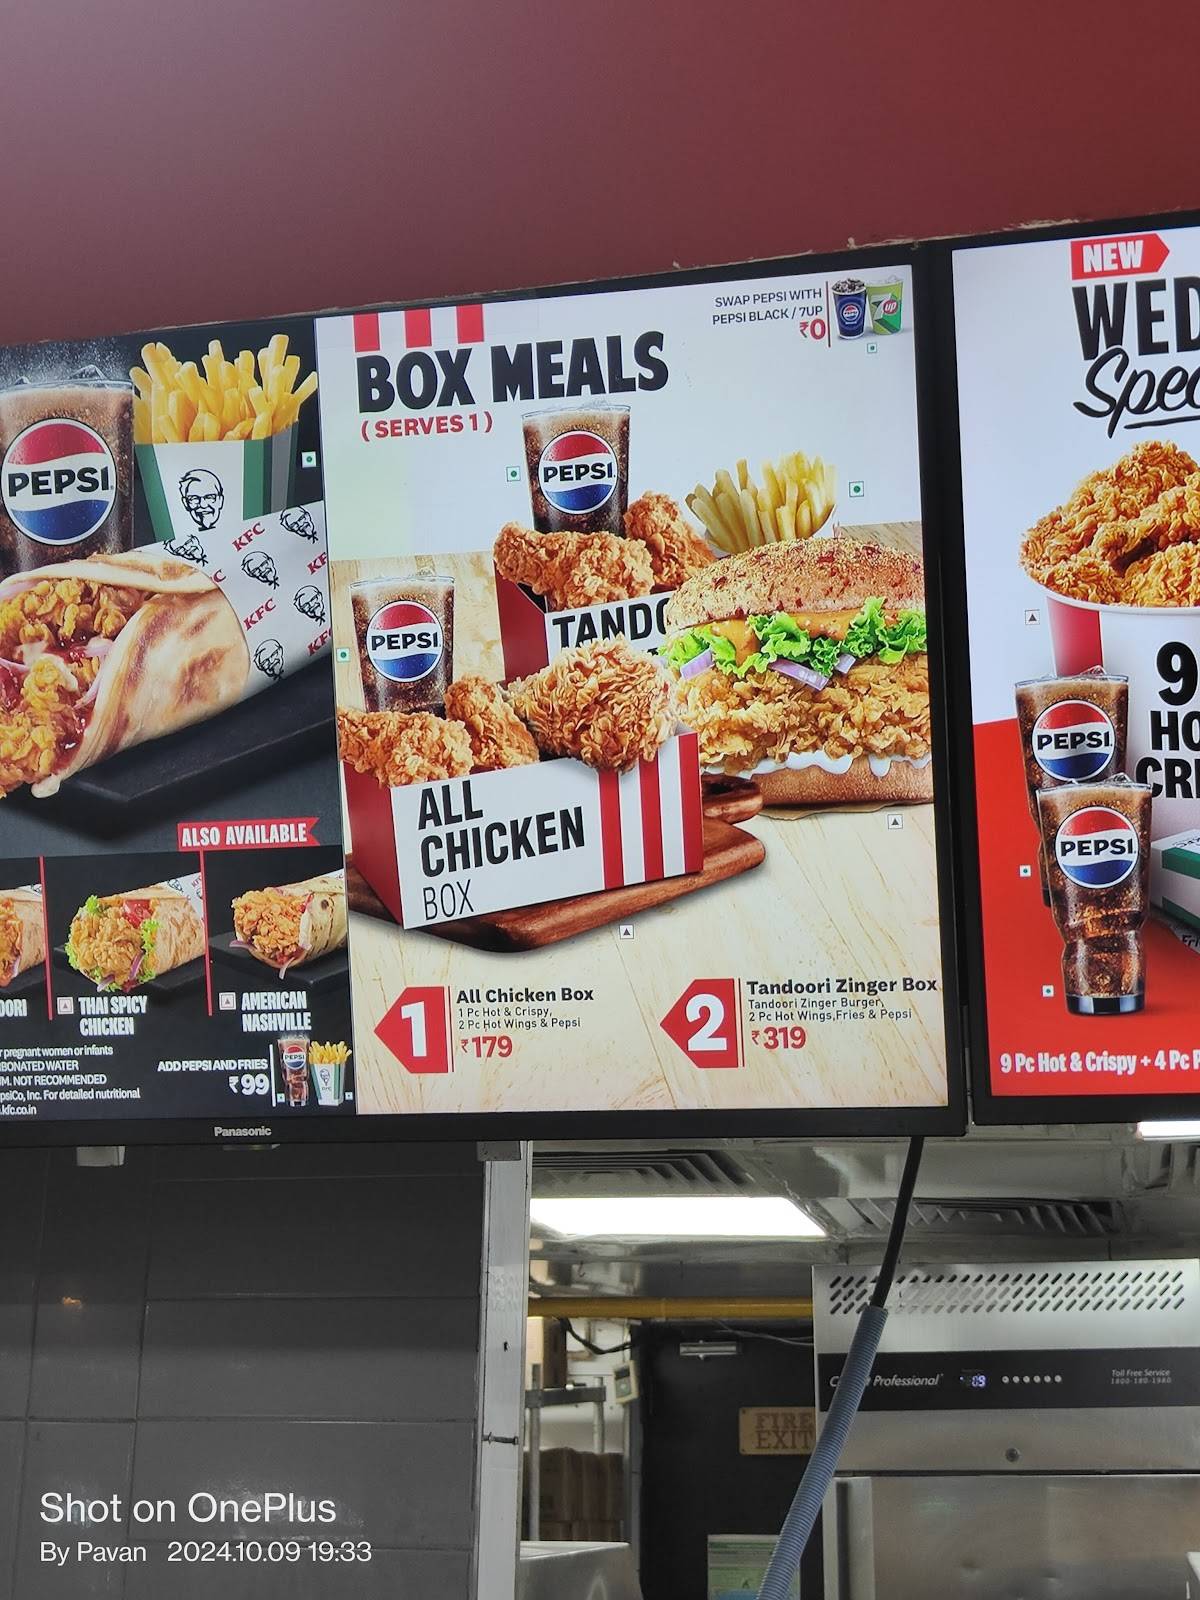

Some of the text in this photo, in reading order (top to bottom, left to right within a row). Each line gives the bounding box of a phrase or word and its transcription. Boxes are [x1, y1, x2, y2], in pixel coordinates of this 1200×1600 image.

[1083, 240, 1144, 273] NEW
[715, 288, 822, 307] SWAP PEPSI WITH
[712, 305, 823, 325] PEPSI BLACK / 7UP
[800, 319, 826, 340] ₹0
[357, 331, 669, 412] BOX MEALS
[8, 466, 110, 497] PEPSI
[542, 463, 614, 483] PEPSI
[232, 523, 265, 551] KFC
[243, 598, 276, 631] KFC
[371, 631, 439, 650] PEPSI
[1156, 641, 1198, 707] 9
[1037, 732, 1110, 750] PEPSI
[418, 780, 483, 830] ALL
[182, 823, 308, 847] ALSO AVAILABLE
[420, 807, 585, 877] CHICKEN
[1060, 839, 1133, 857] PEPSI
[423, 879, 474, 921] BOX
[456, 988, 594, 1003] All Chicken Box
[747, 977, 937, 996] Tandoori Zinger Box
[79, 996, 148, 1015] THAI SPICY
[241, 991, 307, 1011] AMERICAN
[748, 998, 798, 1009] Tandoori
[801, 998, 837, 1010] Zinger
[242, 1012, 312, 1032] NASHVILLE
[459, 1007, 553, 1018] 1 Pc Hot & Crispy,
[687, 994, 728, 1051] 2
[749, 1012, 755, 1021] 2
[759, 1012, 772, 1021] Pc
[775, 1011, 794, 1020] Hot
[868, 1010, 876, 1018] &
[881, 1009, 912, 1021] Pepsi
[80, 1017, 135, 1036] CHICKEN
[401, 1001, 427, 1057] 1
[459, 1017, 581, 1030] 2 Pc Hot Wings & Pepsi
[460, 1036, 513, 1058] ₹179
[751, 1026, 807, 1050] ₹319
[4, 1047, 41, 1059] pregnant
[42, 1047, 73, 1057] women
[74, 1047, 83, 1056] or
[84, 1045, 114, 1055] infants
[46, 1060, 79, 1071] WATER
[157, 1059, 268, 1072] ADD PEPSI AND FRIES
[1000, 1053, 1012, 1073] 9
[1015, 1053, 1035, 1072] Pc
[1038, 1053, 1067, 1072] Hot
[1070, 1052, 1082, 1071] &
[1085, 1051, 1137, 1075] Crispy
[1140, 1056, 1151, 1067] +
[1154, 1050, 1166, 1070] 4
[1169, 1050, 1190, 1070] Pc
[13, 1075, 33, 1086] NOT
[35, 1074, 107, 1085] RECOMMENDED
[229, 1073, 269, 1096] ₹99
[27, 1090, 42, 1100] Inc.
[44, 1089, 58, 1099] For
[59, 1088, 94, 1100] detailed
[95, 1087, 140, 1099] nutritional
[214, 1126, 272, 1137] Panasonic
[873, 1374, 940, 1387] Professional
[1111, 1368, 1171, 1377] Toll Free Service
[756, 1412, 812, 1430] FIRE
[756, 1430, 813, 1450] EXIT
